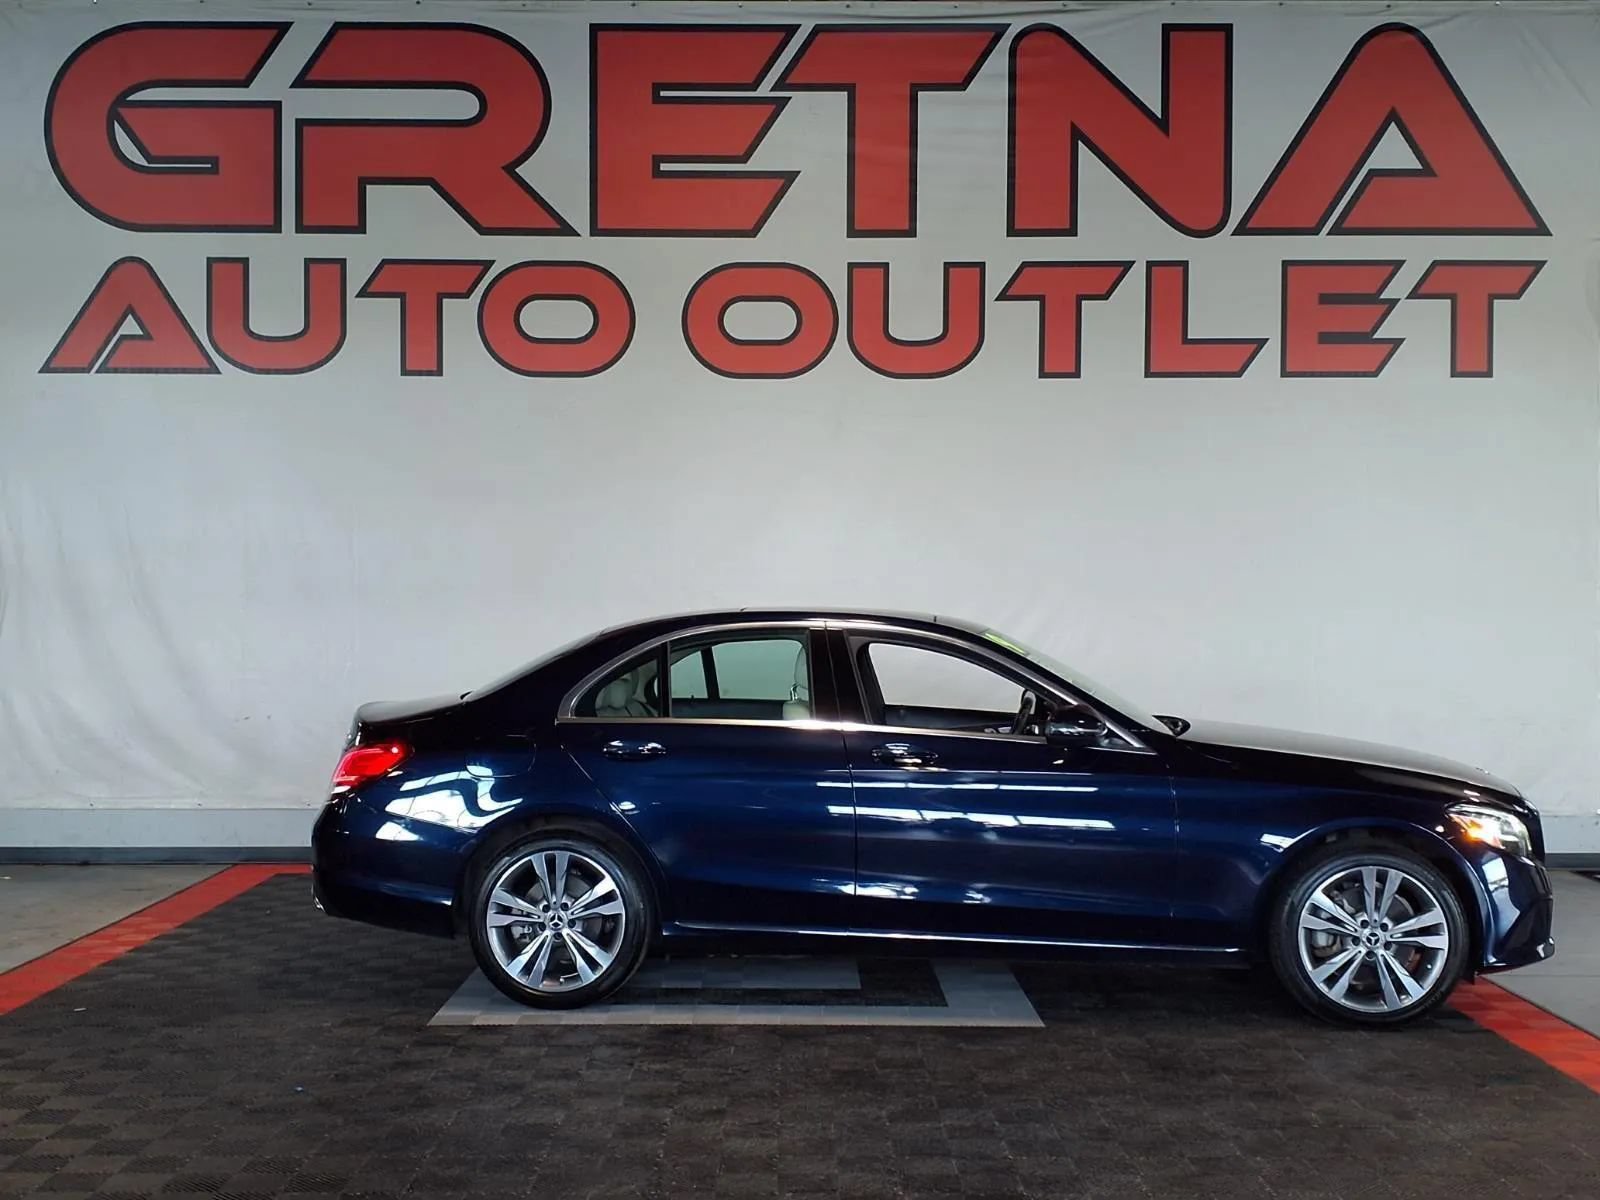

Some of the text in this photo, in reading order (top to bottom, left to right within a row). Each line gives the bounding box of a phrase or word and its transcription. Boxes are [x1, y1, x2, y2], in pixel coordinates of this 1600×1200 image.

[44, 21, 1552, 238] GRETNA
[39, 256, 1547, 379] AUTO OUTLET
